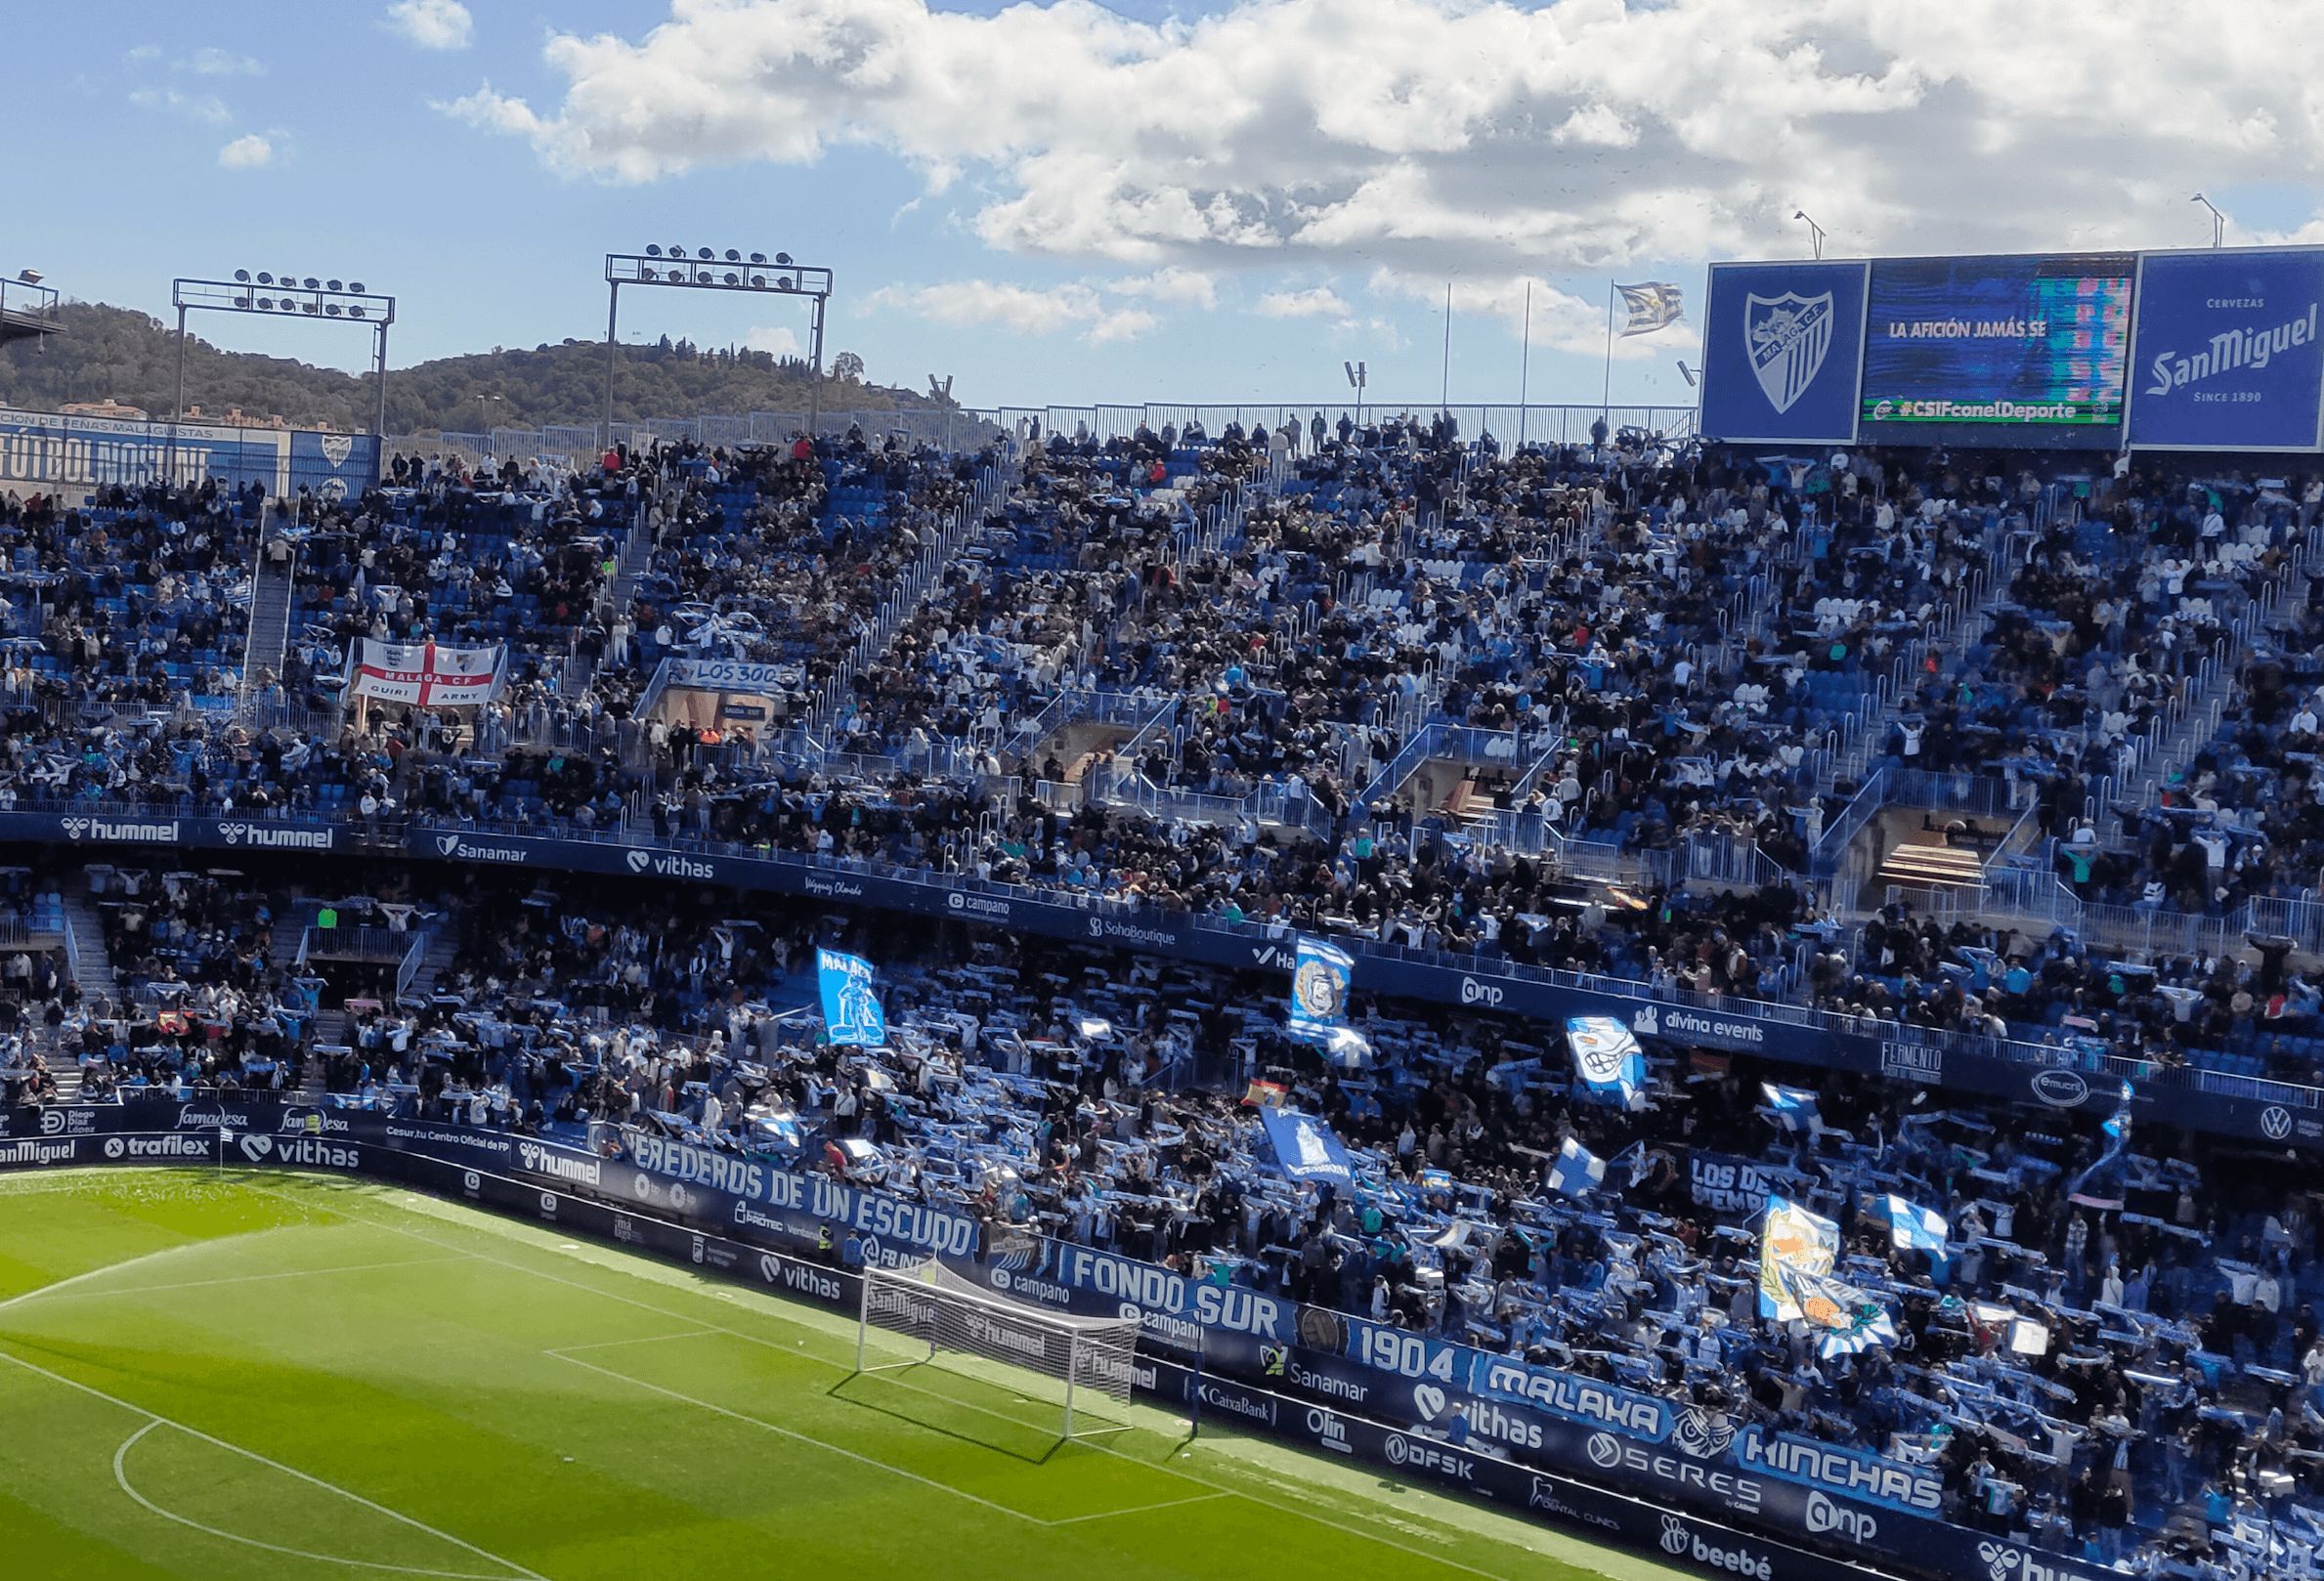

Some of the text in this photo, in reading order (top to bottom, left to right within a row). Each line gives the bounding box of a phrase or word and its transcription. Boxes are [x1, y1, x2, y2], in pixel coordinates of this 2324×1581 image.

[2207, 298, 2264, 309] CERVEZAS
[1889, 317, 2047, 338] LA AFICIÓN JAMÁS SE
[2193, 392, 2261, 403] SINCE 1890
[1899, 401, 2077, 422] #CSIFconelDeporte
[39, 416, 60, 427] DE
[112, 422, 213, 439] MALAGUISTAS
[384, 671, 443, 684] MALAGA
[697, 662, 733, 680] LOS
[370, 684, 479, 701] GUIRI ARMY
[92, 819, 179, 842] hummel
[247, 824, 332, 849] hummel
[457, 843, 527, 863] Sanamar
[655, 856, 714, 879] vithas
[967, 896, 1010, 916] campano
[1105, 920, 1175, 948] SohoBoutique
[1665, 1011, 1710, 1033] divina
[1714, 1022, 1764, 1042] events
[67, 1110, 95, 1120] Diego
[174, 1103, 248, 1130] famadesa
[128, 1135, 210, 1155] trafilex
[428, 1131, 459, 1142] Centro
[460, 1135, 486, 1148] Oficial
[487, 1141, 497, 1150] de
[278, 1141, 359, 1169] vithas
[539, 1152, 600, 1185] hummel
[1692, 1158, 1736, 1189] LOS
[770, 1171, 806, 1211] DE
[813, 1174, 851, 1222] UN
[856, 1194, 971, 1258] ESCUDO
[746, 1215, 820, 1242] PROTEC Ventana
[785, 1265, 840, 1301] vithas
[1014, 1275, 1070, 1303] campano
[1074, 1251, 1279, 1344] FONDO SUR
[1144, 1311, 1204, 1342] campano
[1361, 1326, 1455, 1384] 1904
[1289, 1363, 1368, 1403] Sanamar
[1209, 1389, 1270, 1421] CaixaBank
[1307, 1408, 1347, 1441] Olin
[1408, 1443, 1474, 1481] DFSK
[1625, 1447, 1761, 1503] SERES
[1693, 1534, 1772, 1581] beebé
